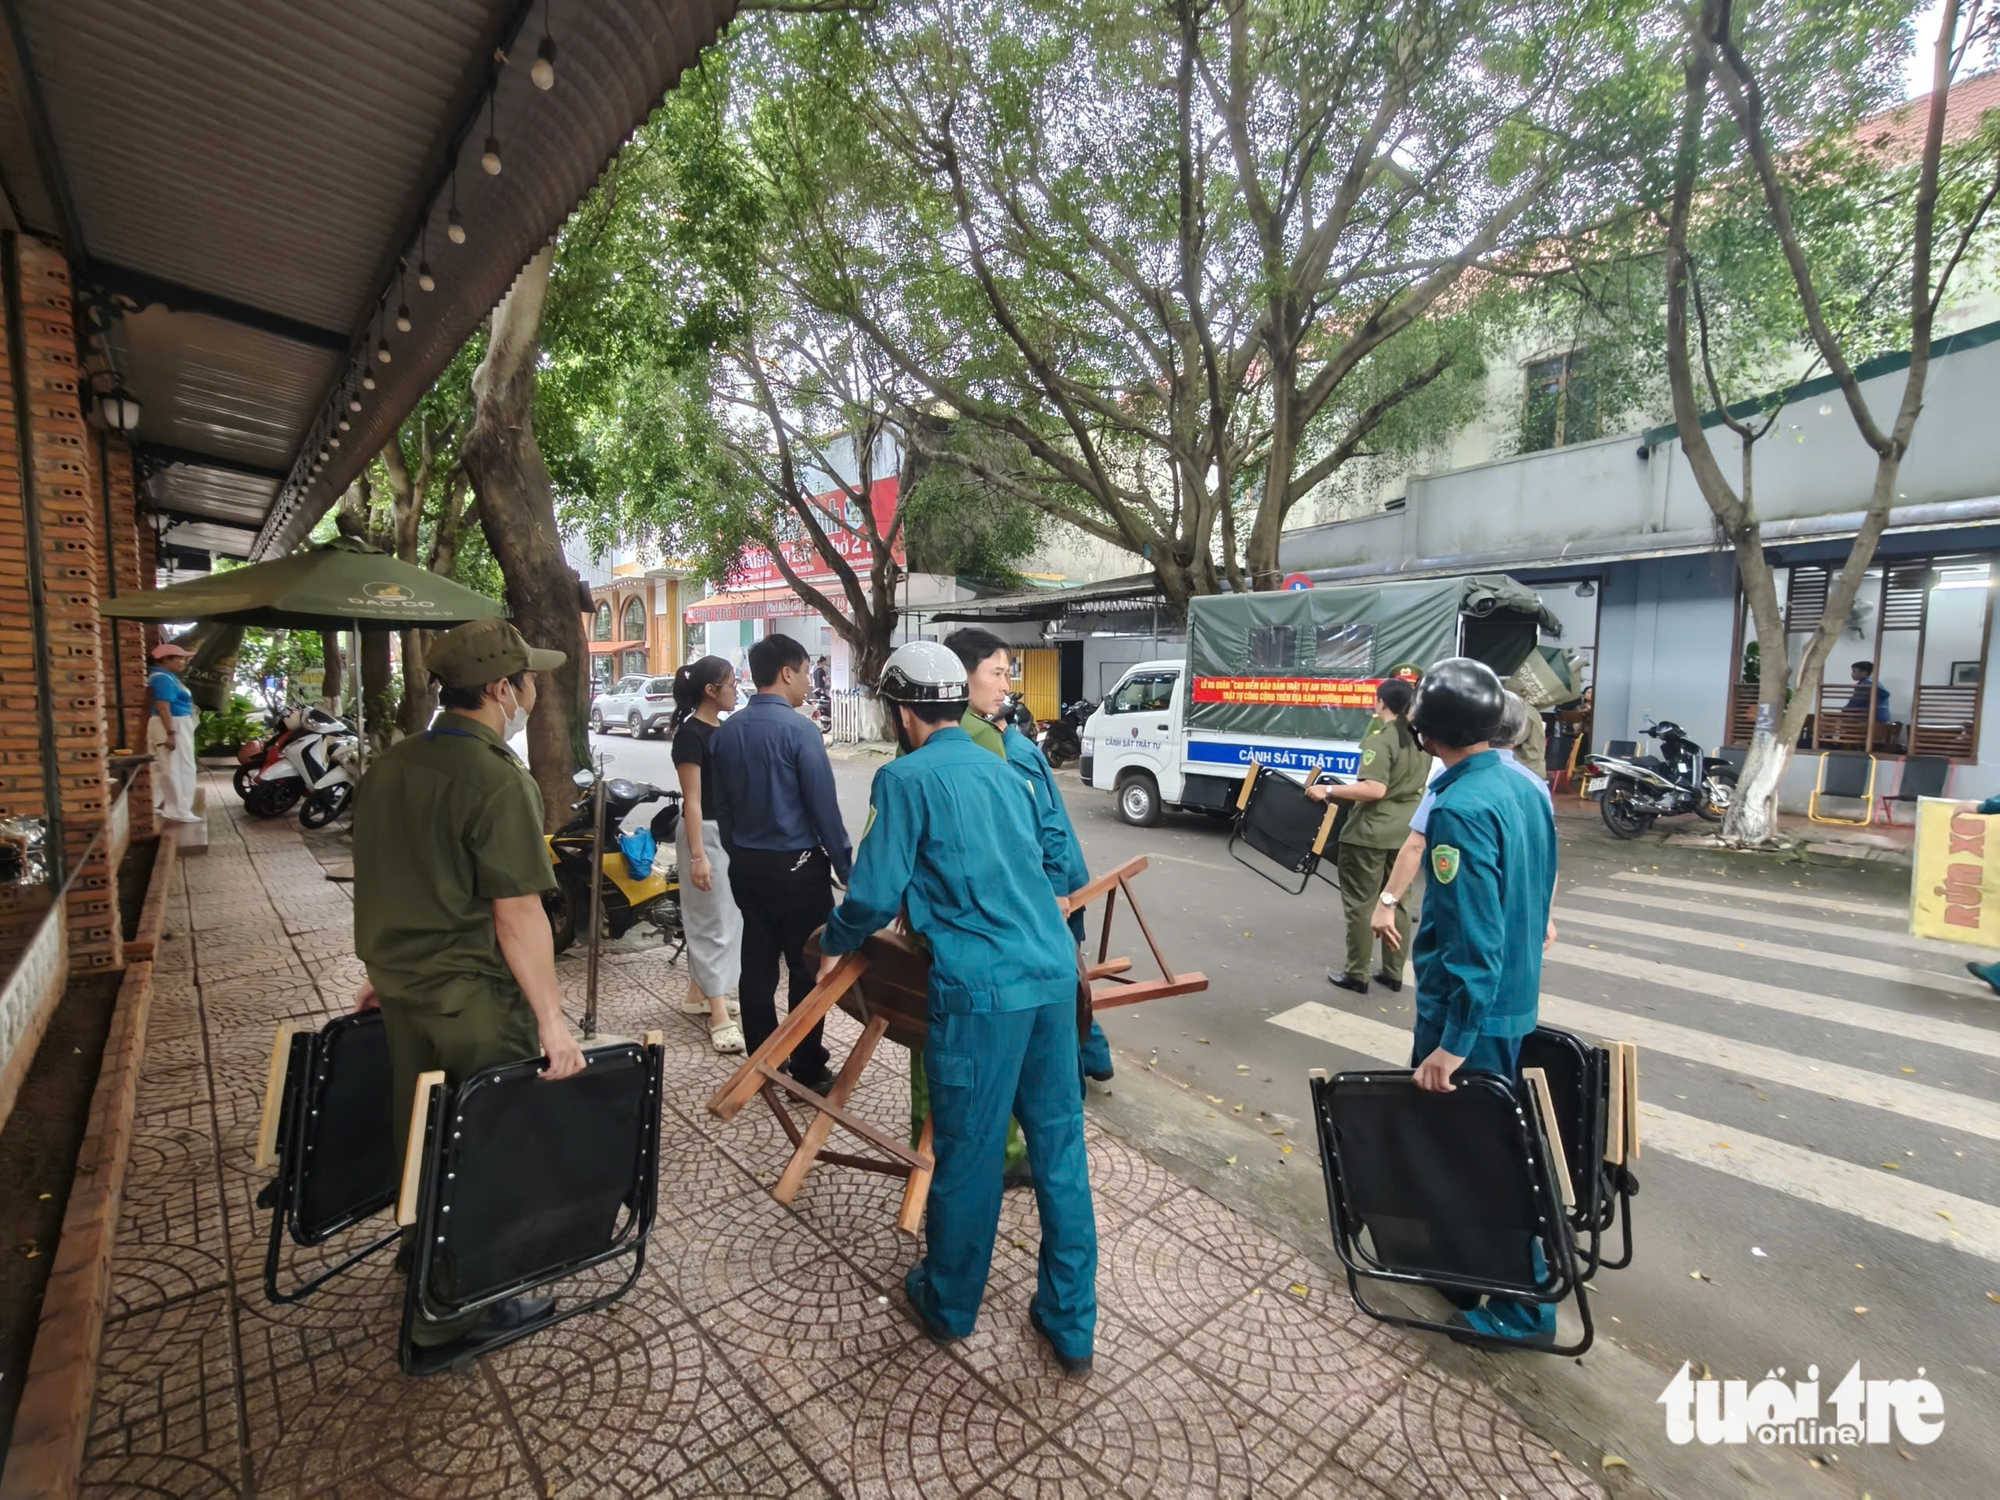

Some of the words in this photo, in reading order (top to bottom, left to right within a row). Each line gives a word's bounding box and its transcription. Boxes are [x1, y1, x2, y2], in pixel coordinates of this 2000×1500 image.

[1239, 747, 1271, 763] CẢNH
[1274, 750, 1297, 765] SÁT
[1336, 757, 1356, 773] TỰ
